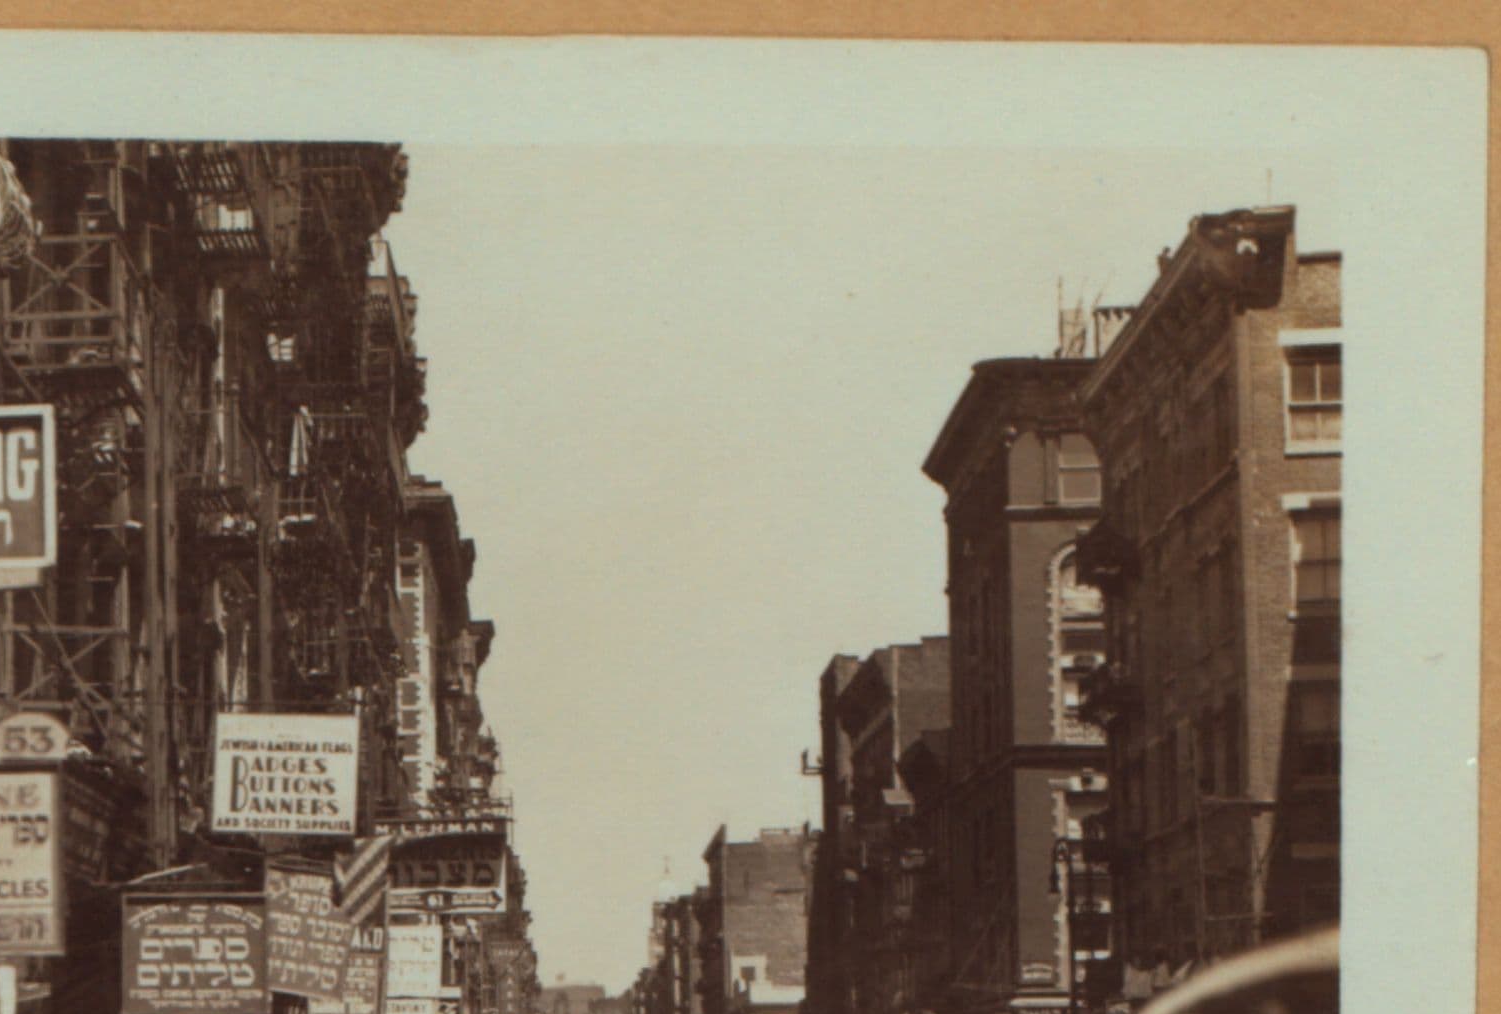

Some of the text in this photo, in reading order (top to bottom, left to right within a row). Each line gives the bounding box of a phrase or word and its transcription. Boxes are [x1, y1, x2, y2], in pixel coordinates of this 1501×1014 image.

[3, 727, 56, 754] 53
[267, 740, 318, 752] AMERICAN
[215, 817, 240, 828] AND
[244, 817, 291, 829] SOCIETY
[140, 936, 250, 961] ספרים
[136, 963, 256, 987] טליתים
